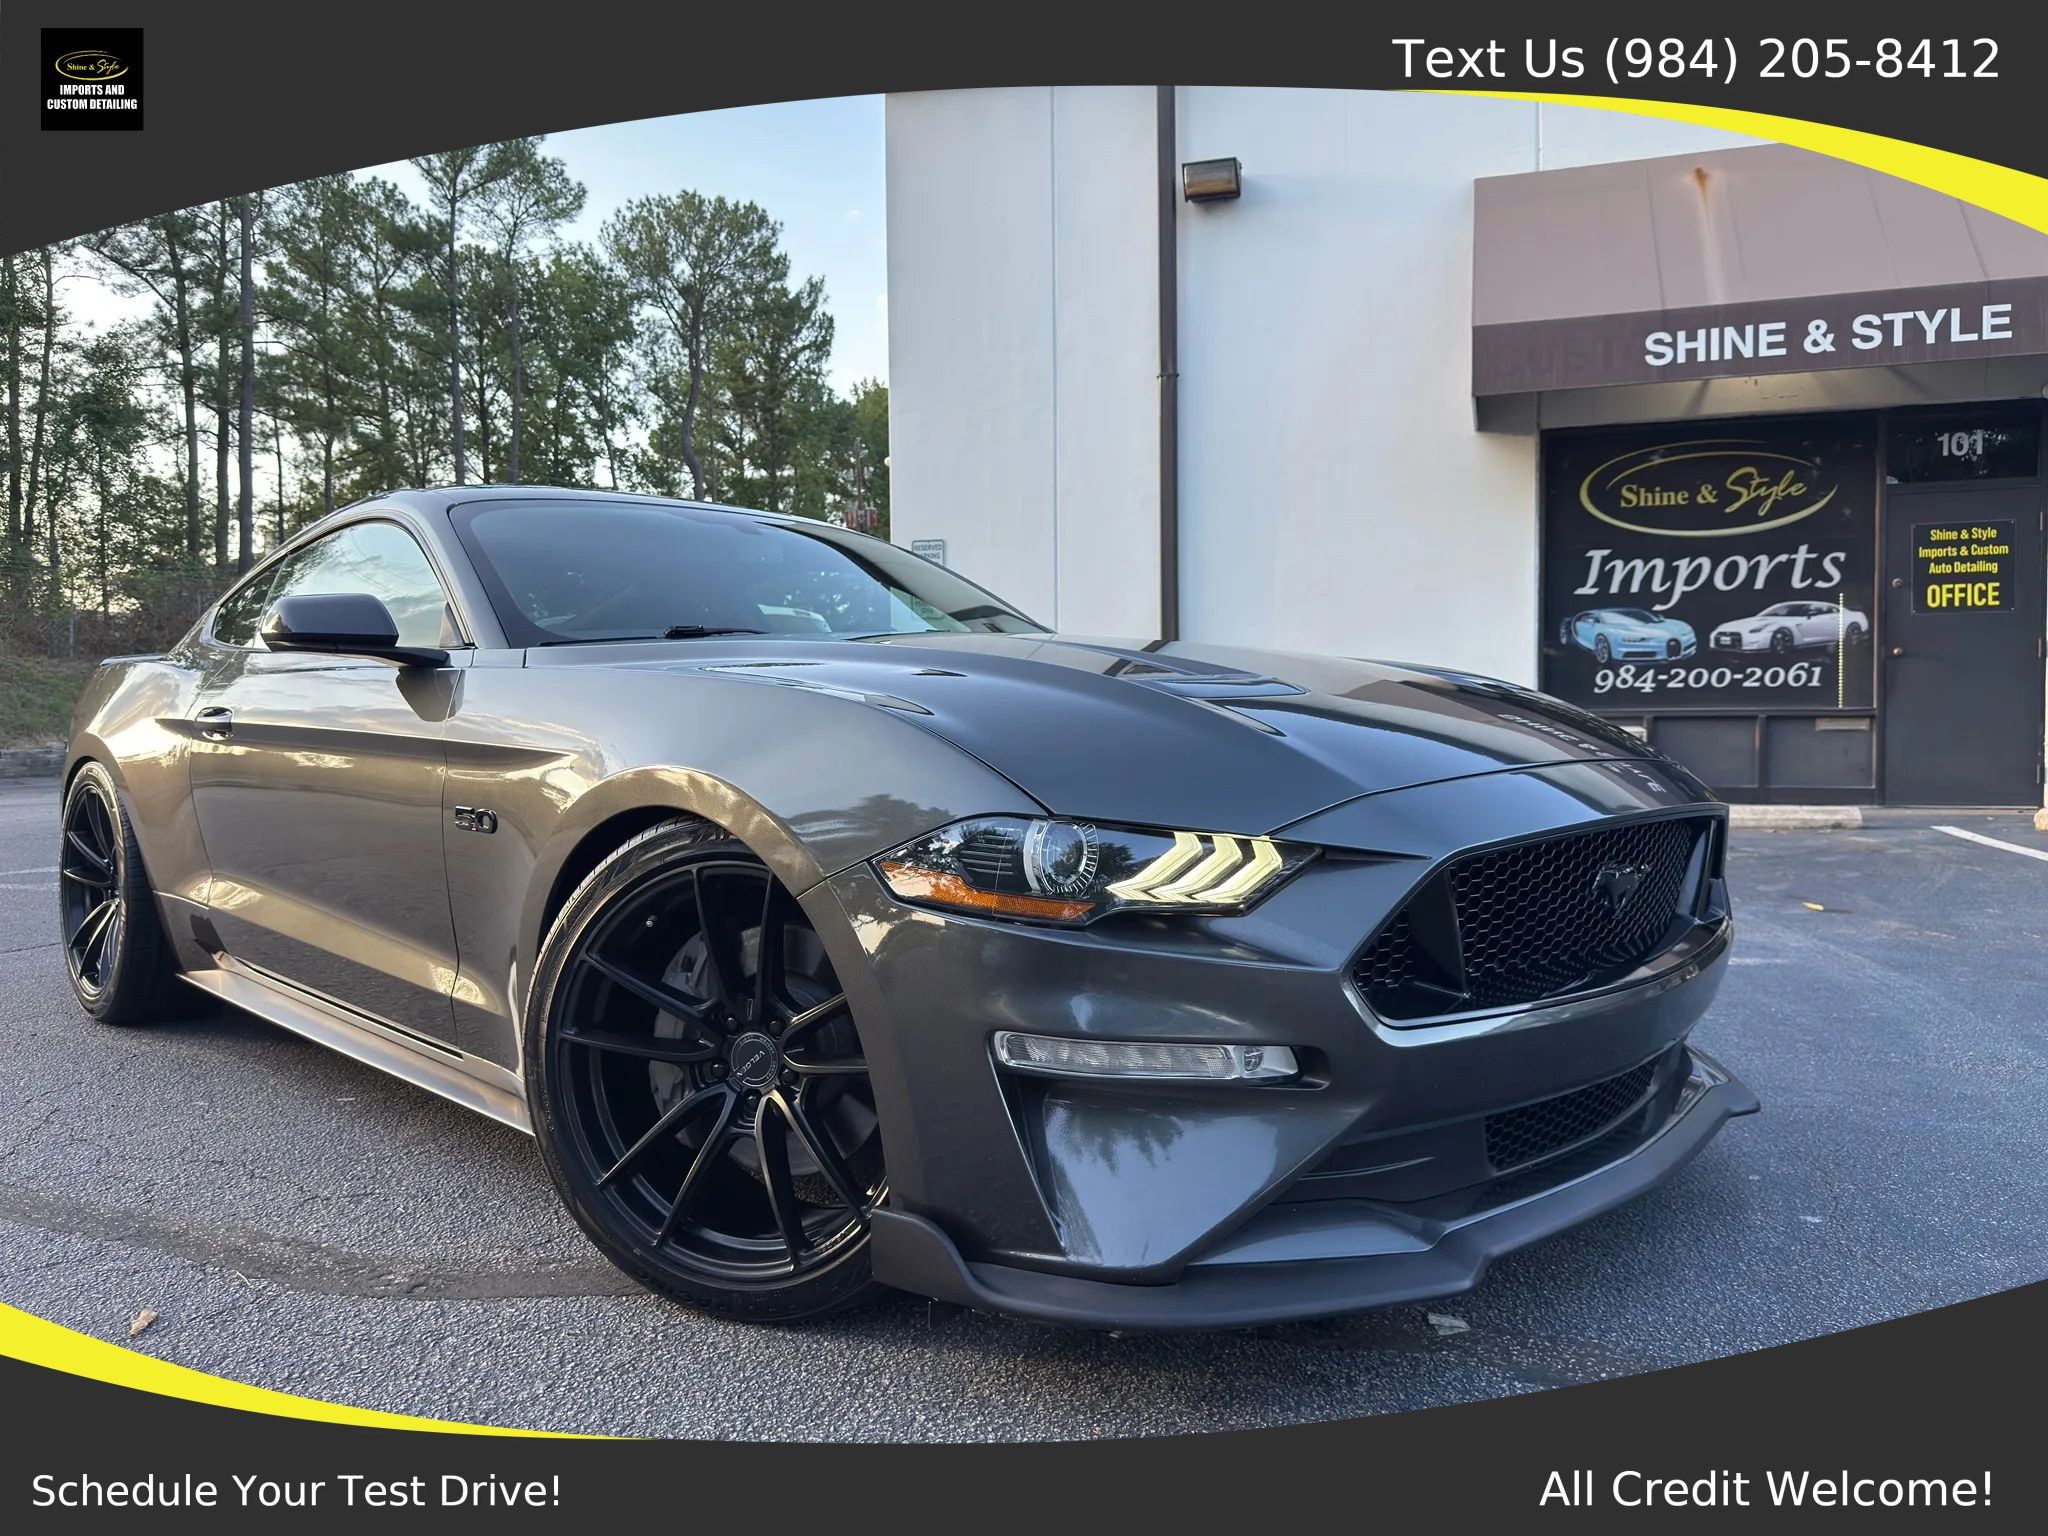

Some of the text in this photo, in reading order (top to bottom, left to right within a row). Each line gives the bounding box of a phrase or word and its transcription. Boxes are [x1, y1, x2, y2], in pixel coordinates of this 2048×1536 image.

[1644, 321, 1787, 368] SHINE
[1802, 318, 1837, 355] &
[1851, 302, 2013, 350] STYLE
[1937, 430, 1983, 457] 101
[1620, 466, 1808, 517] Shine & Style
[914, 543, 942, 552] RESERVED
[1930, 526, 1998, 541] Shine & Style
[1918, 543, 2009, 560] Imports & Custom
[1573, 543, 1847, 611] Imports
[1928, 560, 1999, 575] Auto Detailing
[1926, 581, 2001, 609] OFFICE
[1594, 661, 1823, 694] 984-200-2061
[736, 1050, 766, 1078] VELGEN
